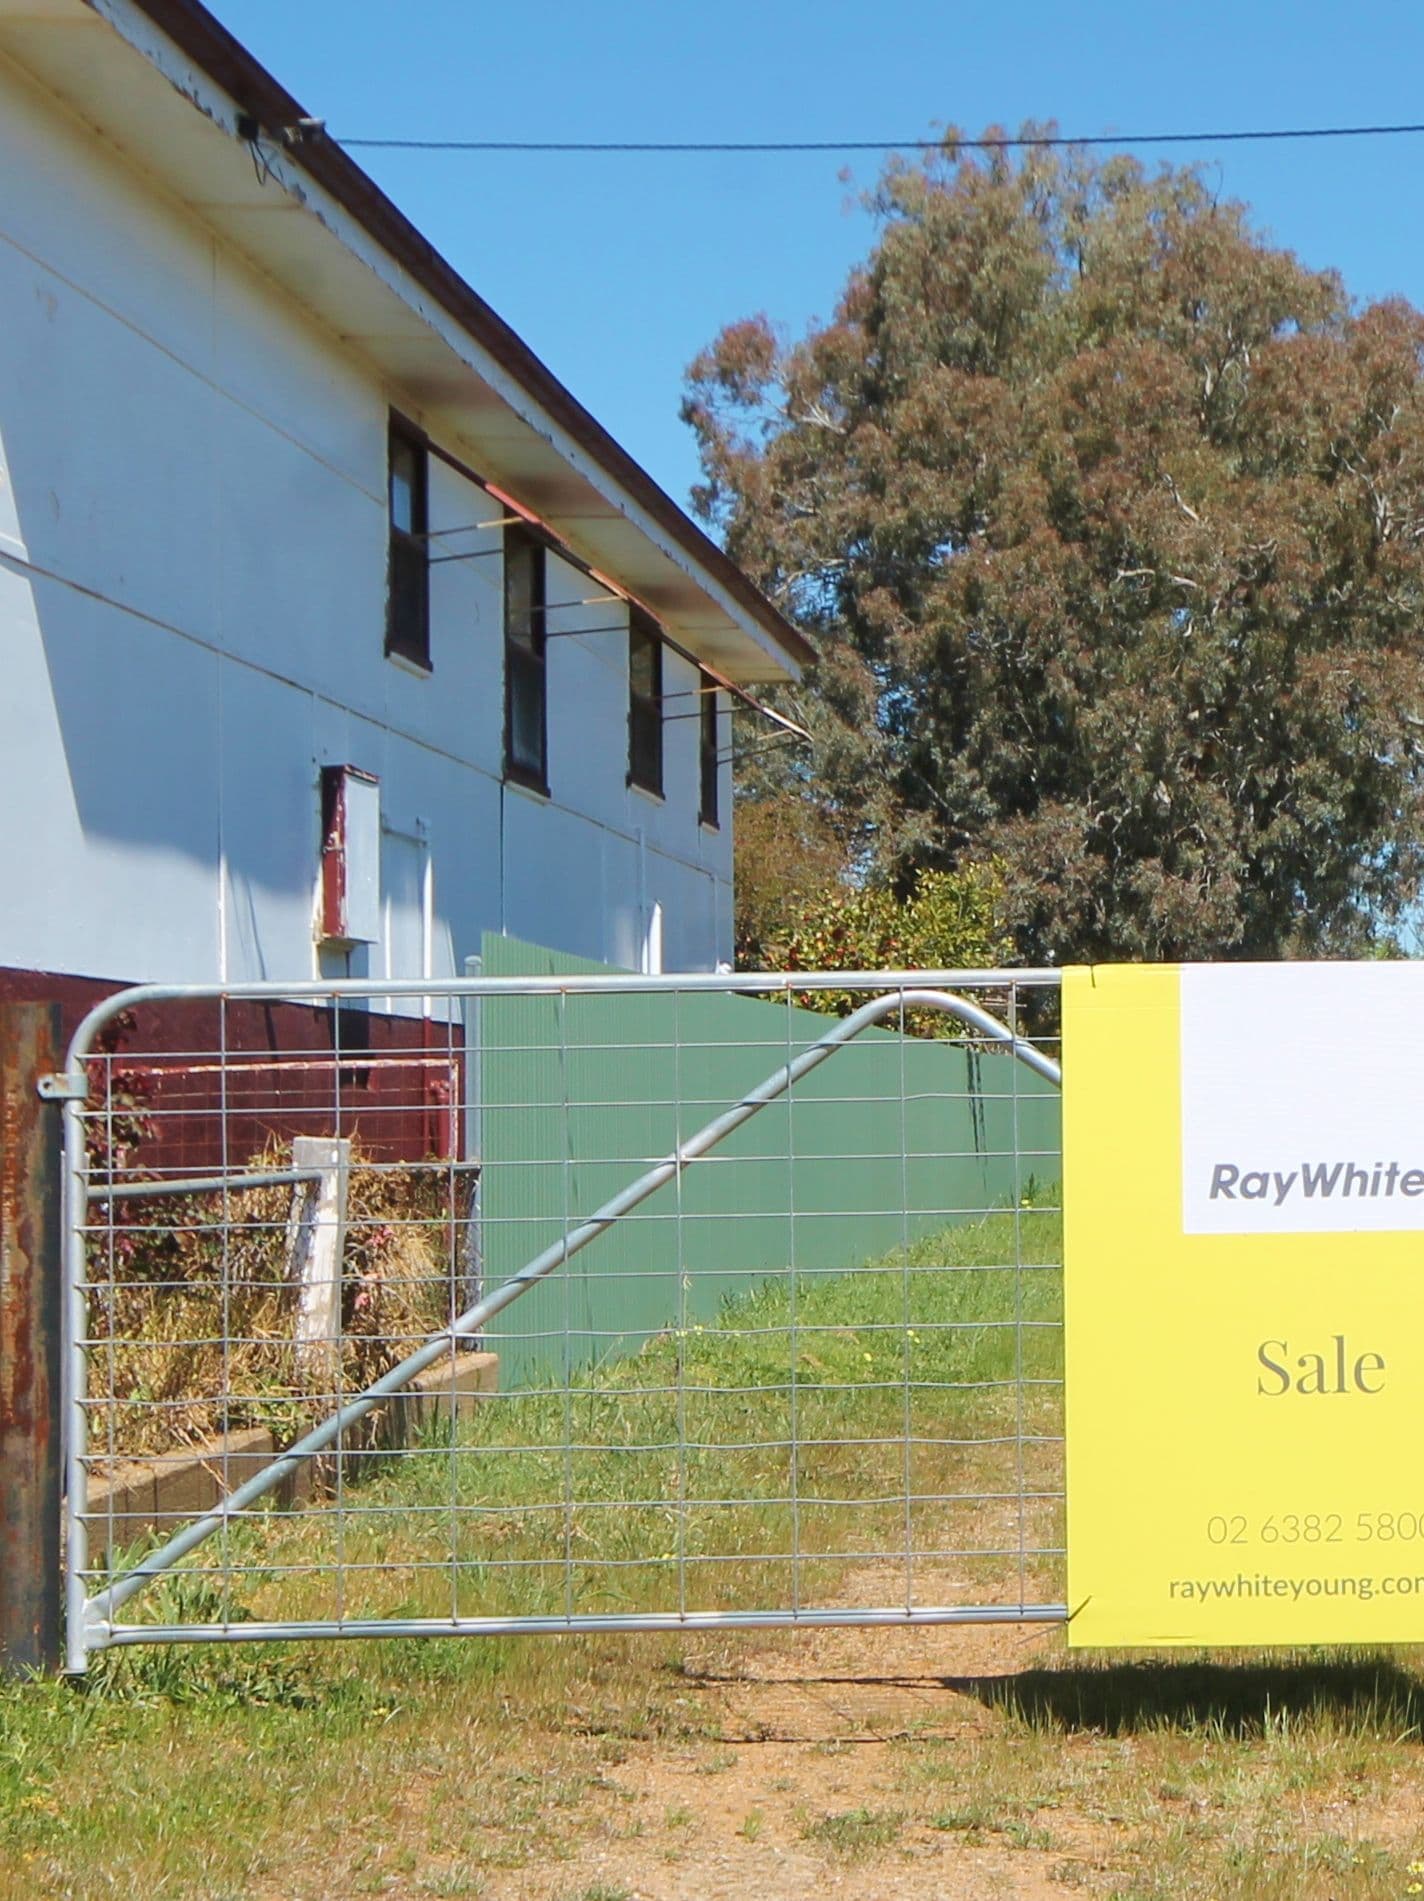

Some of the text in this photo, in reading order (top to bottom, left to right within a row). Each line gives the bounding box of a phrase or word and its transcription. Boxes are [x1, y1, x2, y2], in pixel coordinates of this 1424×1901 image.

[1257, 1335, 1386, 1396] Sale
[1207, 1515, 1248, 1544] 02
[1260, 1514, 1343, 1543] 6382
